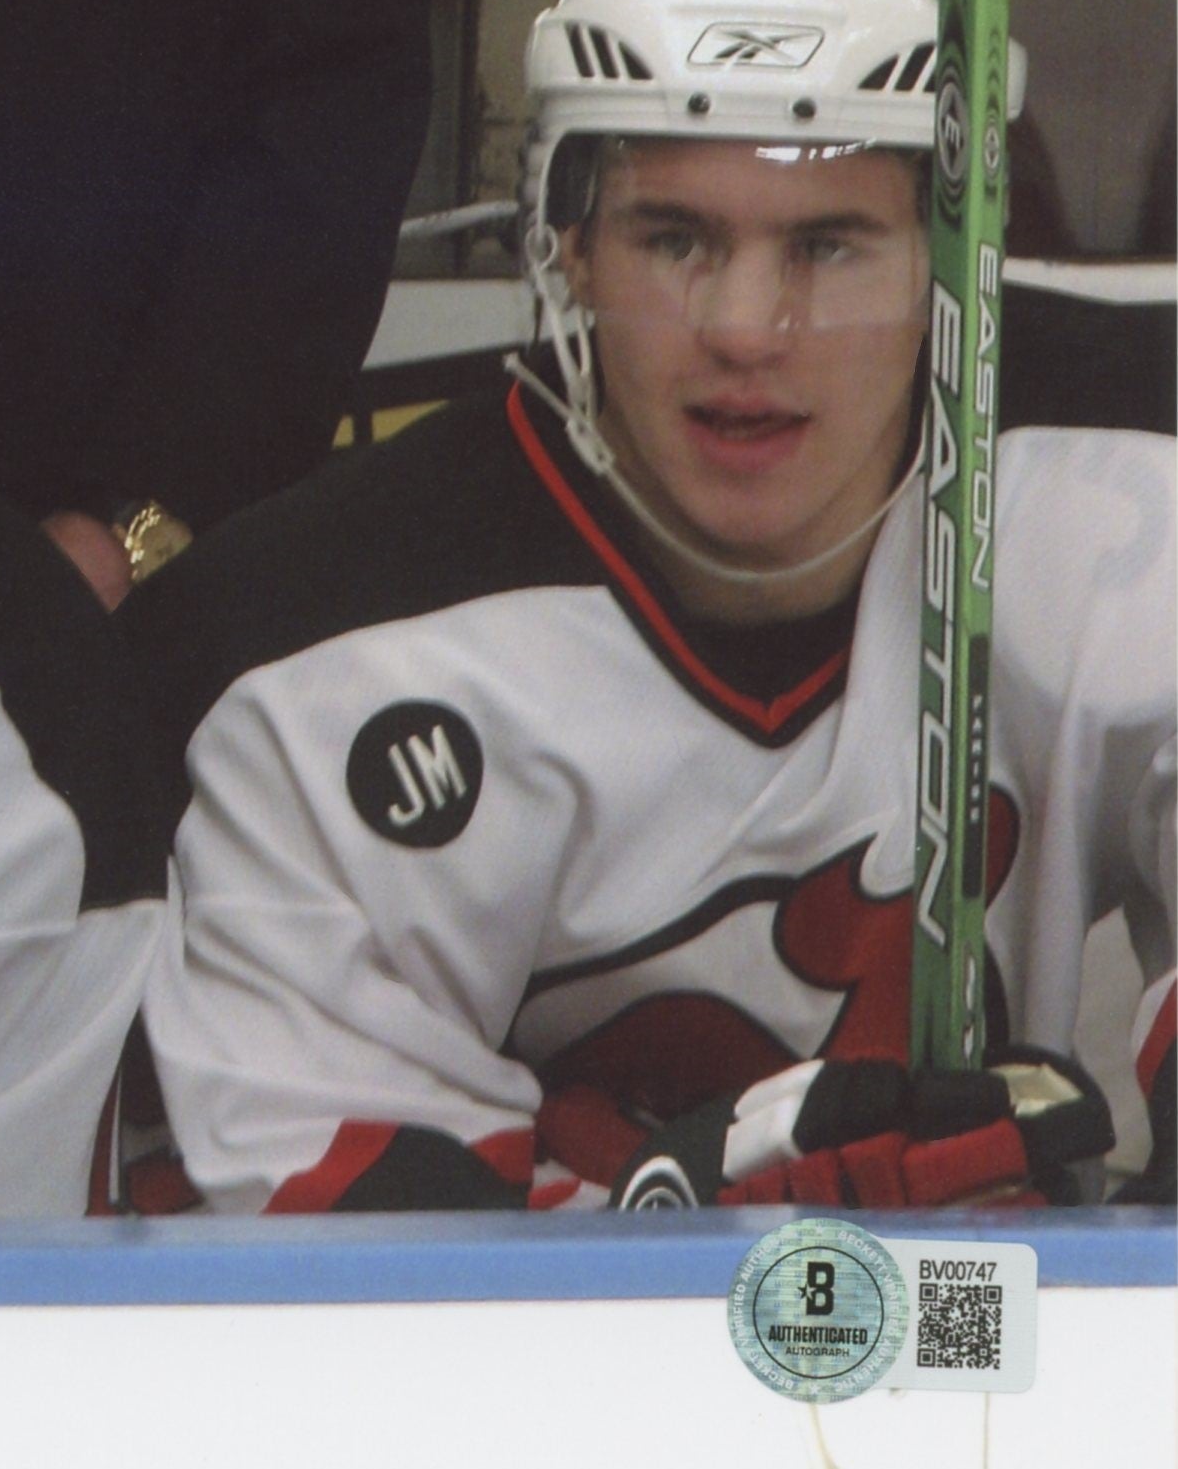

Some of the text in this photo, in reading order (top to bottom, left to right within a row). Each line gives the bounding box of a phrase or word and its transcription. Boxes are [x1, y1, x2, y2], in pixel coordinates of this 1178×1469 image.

[971, 242, 999, 589] EASTON
[919, 279, 962, 948] EASTON
[388, 724, 467, 828] JM
[806, 1261, 835, 1316] B
[919, 1259, 998, 1282] BV00747
[768, 1325, 868, 1345] AUTHENTICATED
[785, 1346, 850, 1357] AUTOGRAPH
